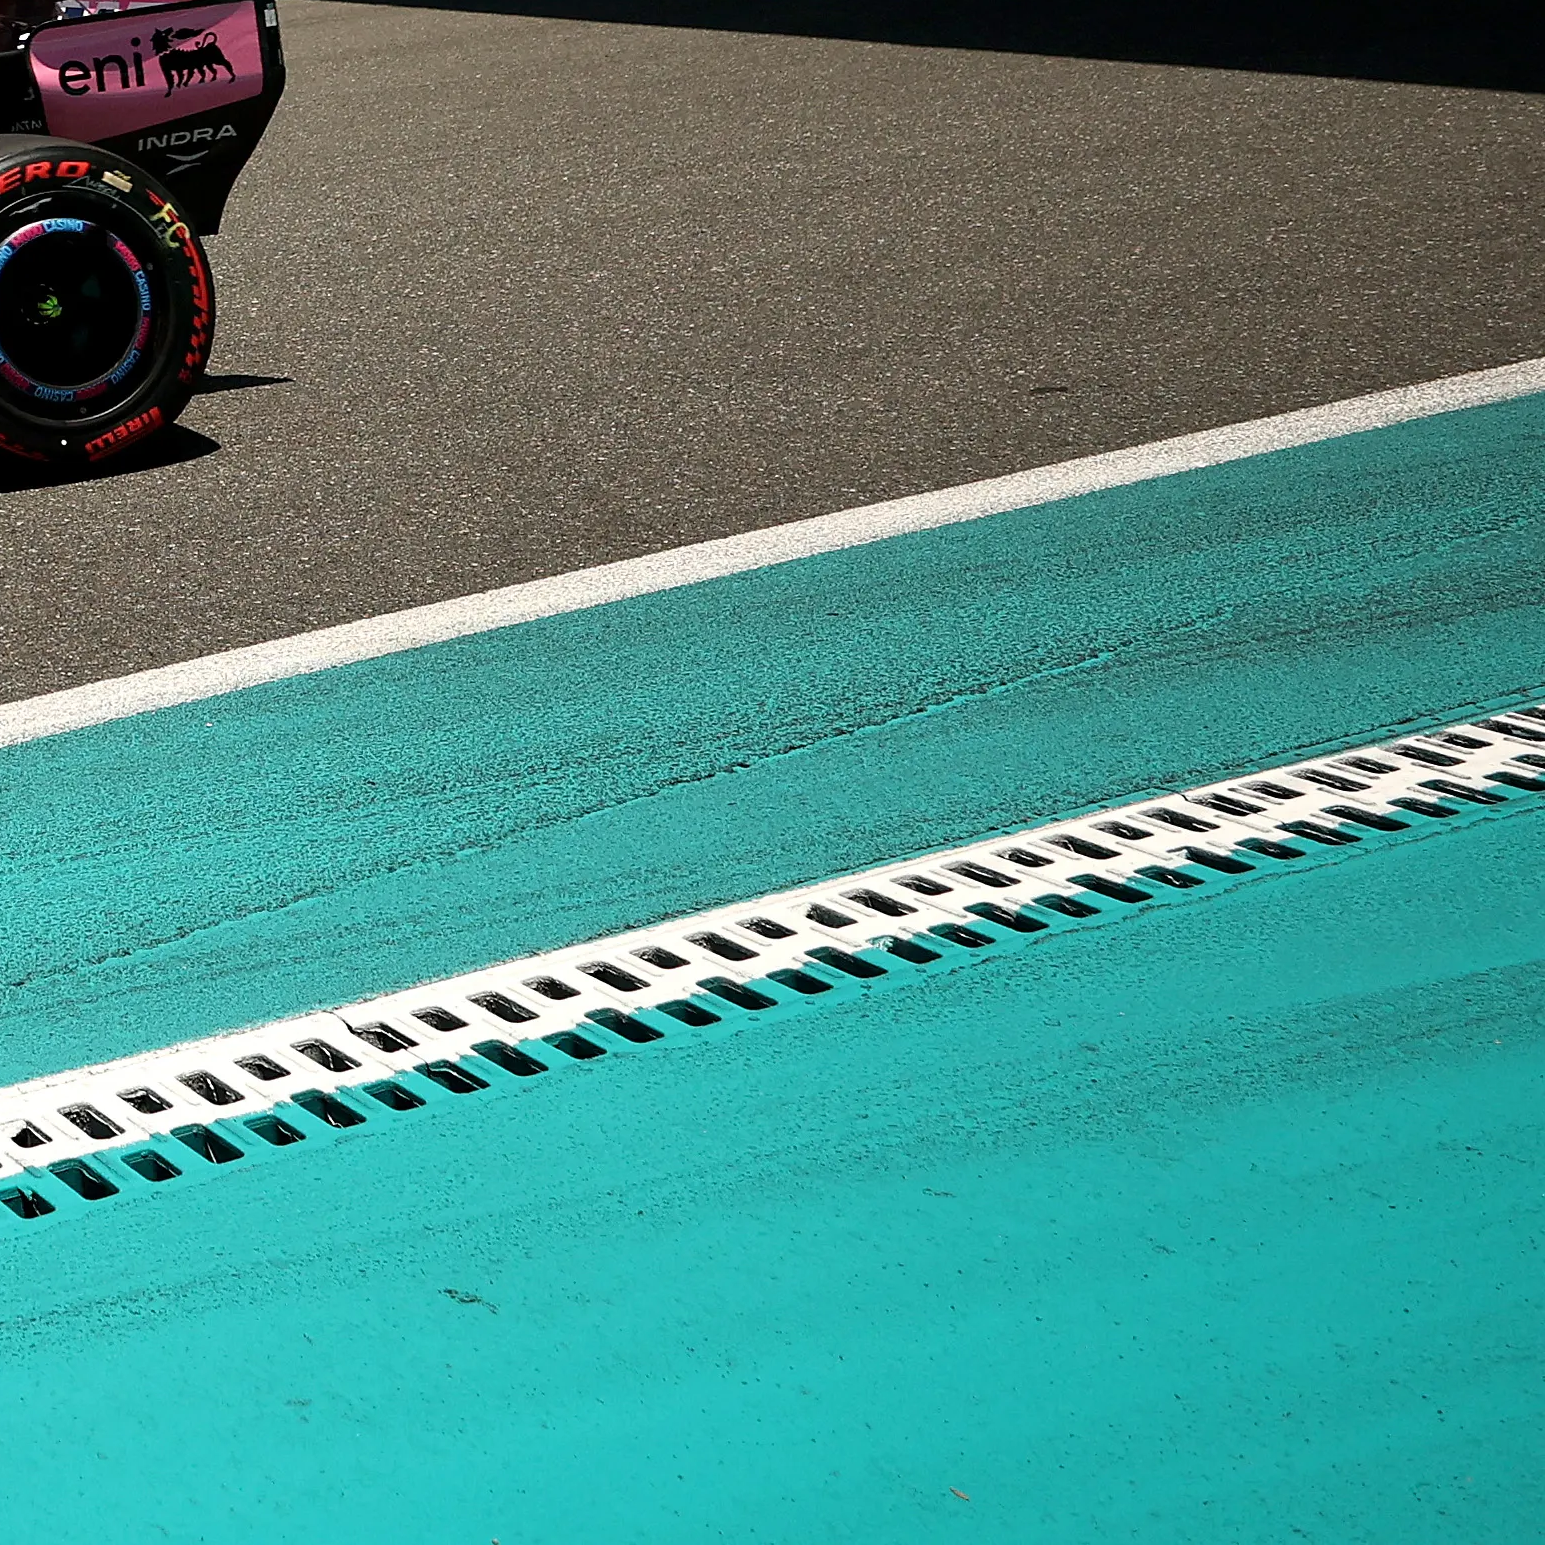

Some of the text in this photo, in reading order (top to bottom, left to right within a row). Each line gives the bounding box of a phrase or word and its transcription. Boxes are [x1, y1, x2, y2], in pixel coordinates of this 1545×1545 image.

[59, 36, 145, 96] eni
[138, 124, 238, 151] INDRA
[42, 218, 85, 232] CASINO
[135, 270, 151, 311] CASINO
